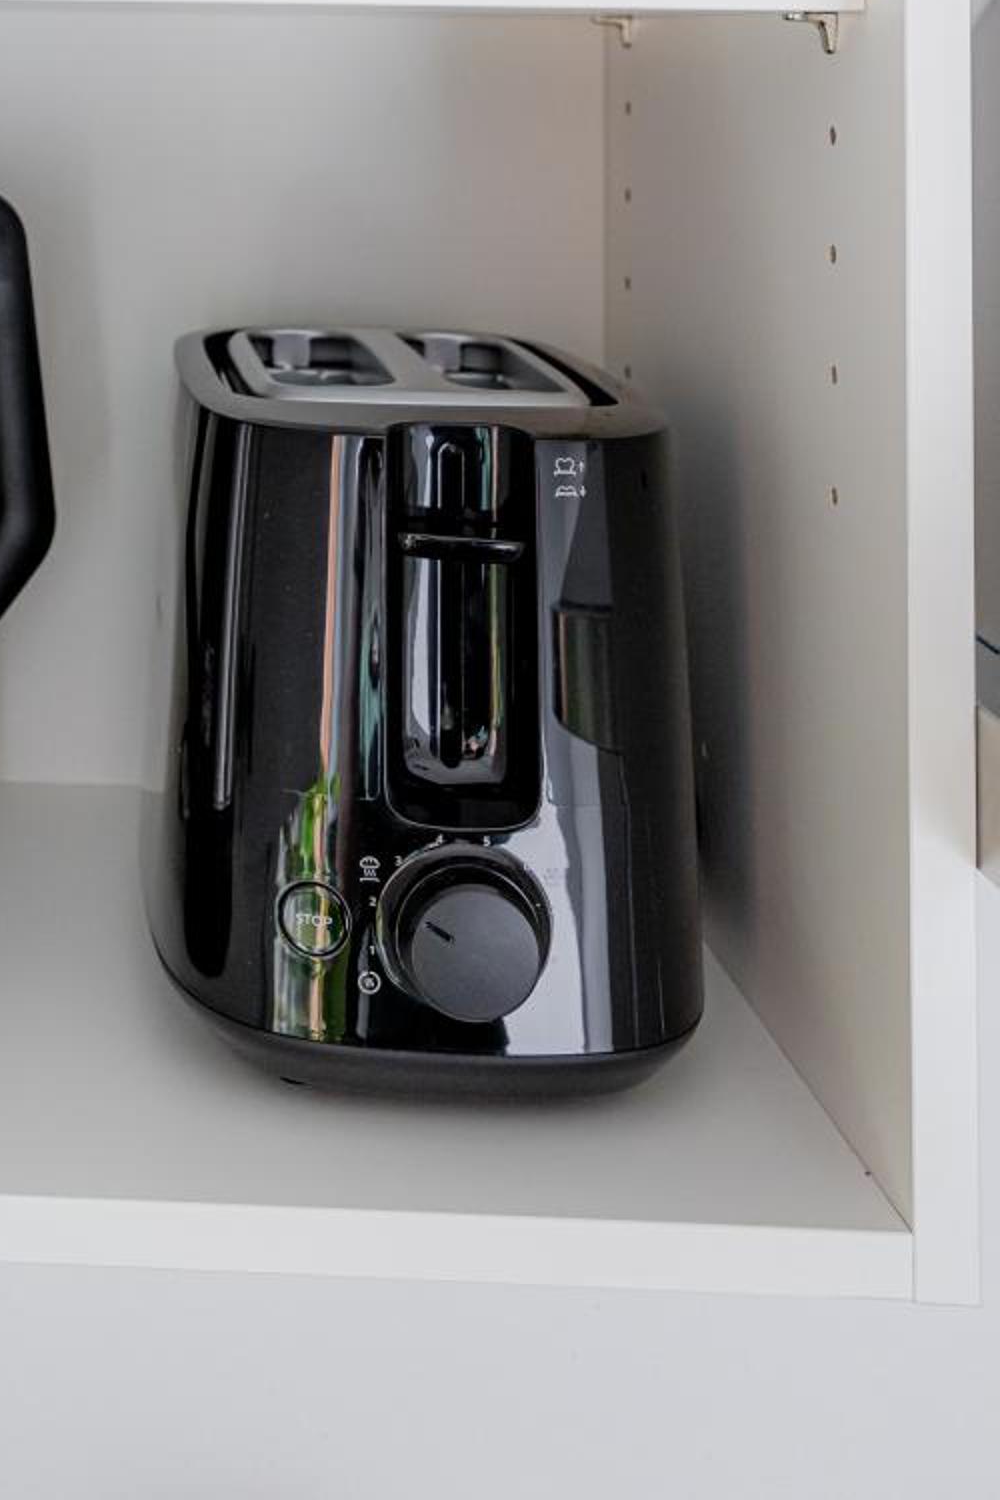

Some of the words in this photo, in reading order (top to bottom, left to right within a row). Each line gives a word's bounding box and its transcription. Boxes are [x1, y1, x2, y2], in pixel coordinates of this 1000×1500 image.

[368, 896, 377, 907] 2
[295, 913, 333, 928] STOP
[368, 945, 376, 956] 1
